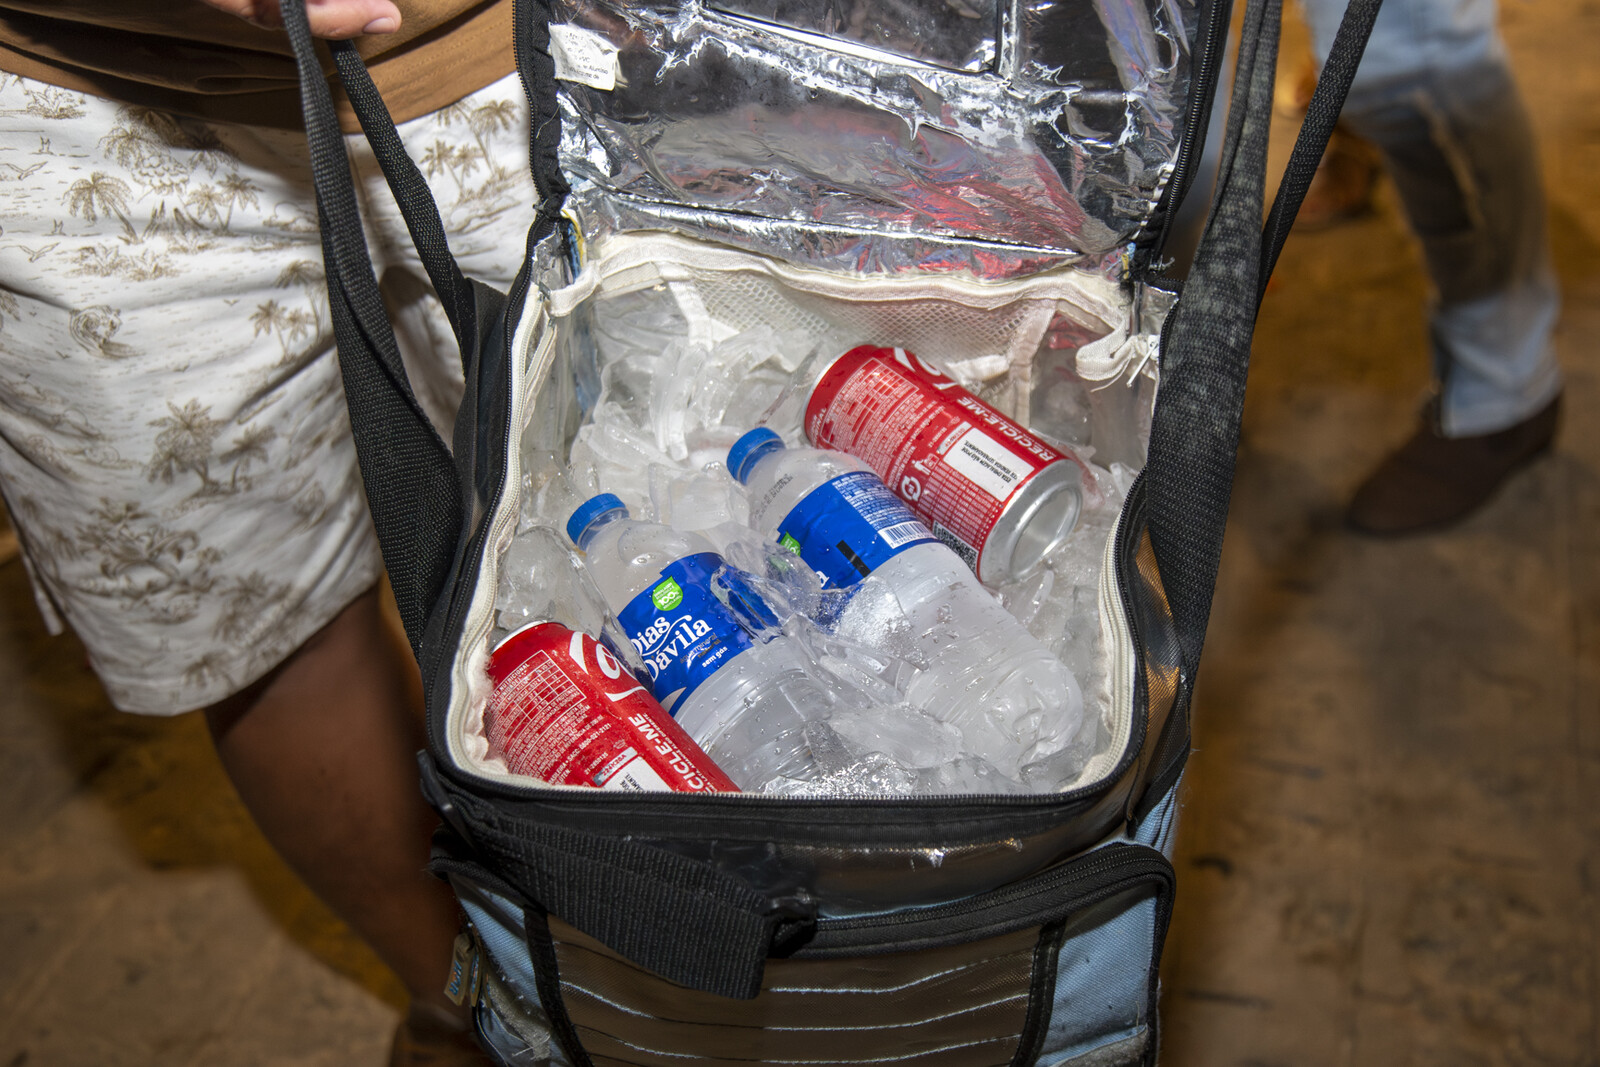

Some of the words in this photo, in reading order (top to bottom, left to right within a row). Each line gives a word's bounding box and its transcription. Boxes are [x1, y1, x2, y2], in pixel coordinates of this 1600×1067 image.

[956, 395, 1054, 461] RECICLE-ME
[701, 654, 716, 667] sem
[715, 645, 728, 658] gás
[498, 663, 529, 691] NUTRICIONAL
[578, 722, 612, 750] 0800-021-2121
[665, 736, 678, 750] ALGO
